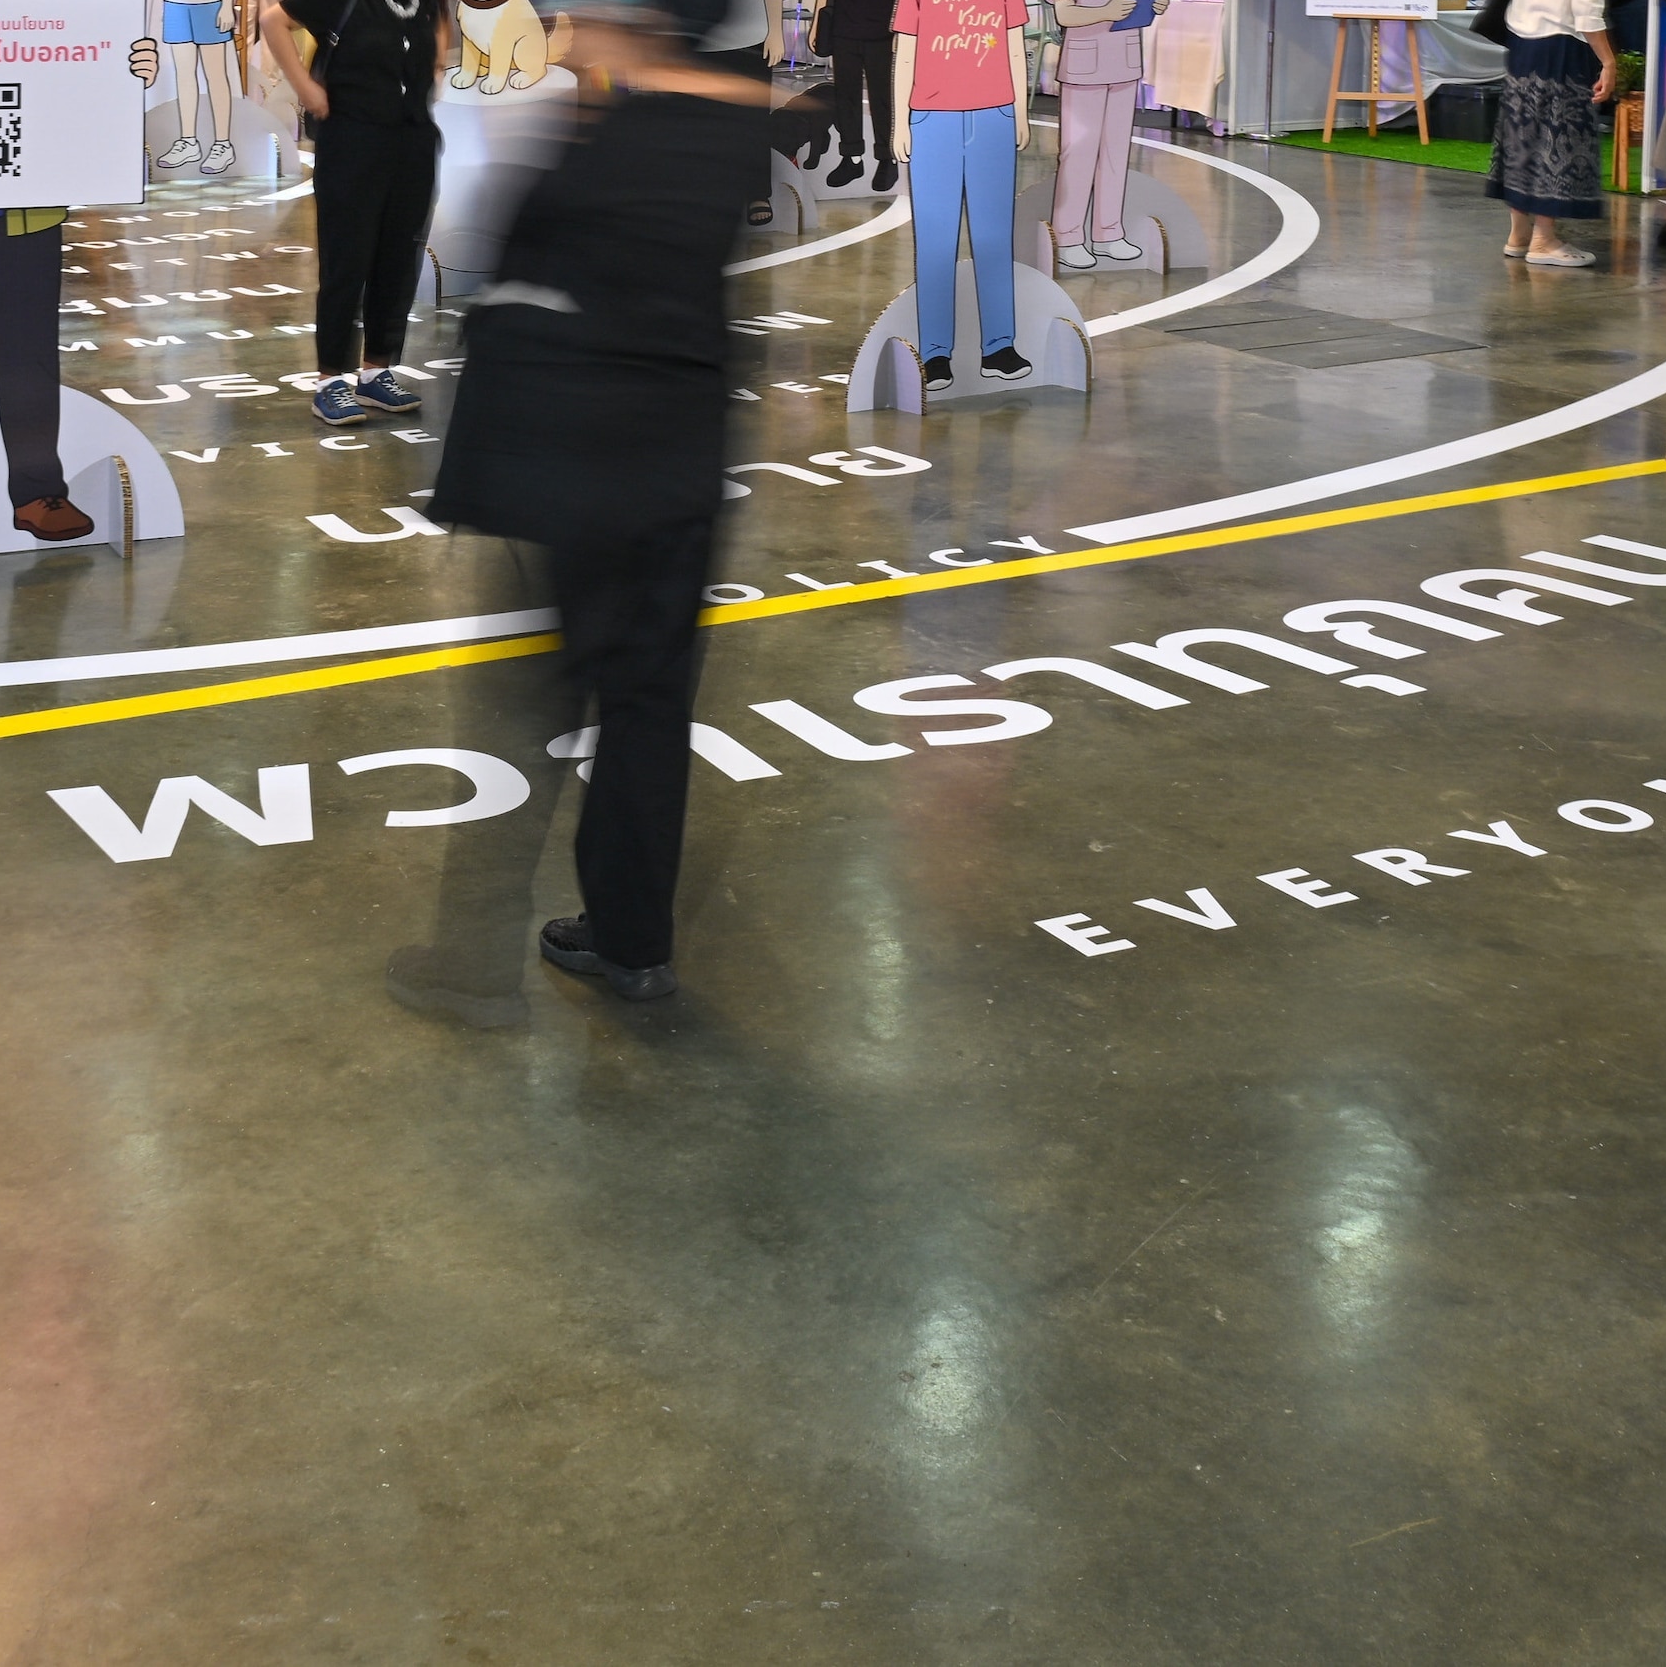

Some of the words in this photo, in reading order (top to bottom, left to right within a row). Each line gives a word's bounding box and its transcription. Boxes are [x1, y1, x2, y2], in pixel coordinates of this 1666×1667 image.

[958, 4, 1003, 35] ชุมชน
[931, 32, 981, 60] กรุณา
[702, 535, 1057, 605] OLICY
